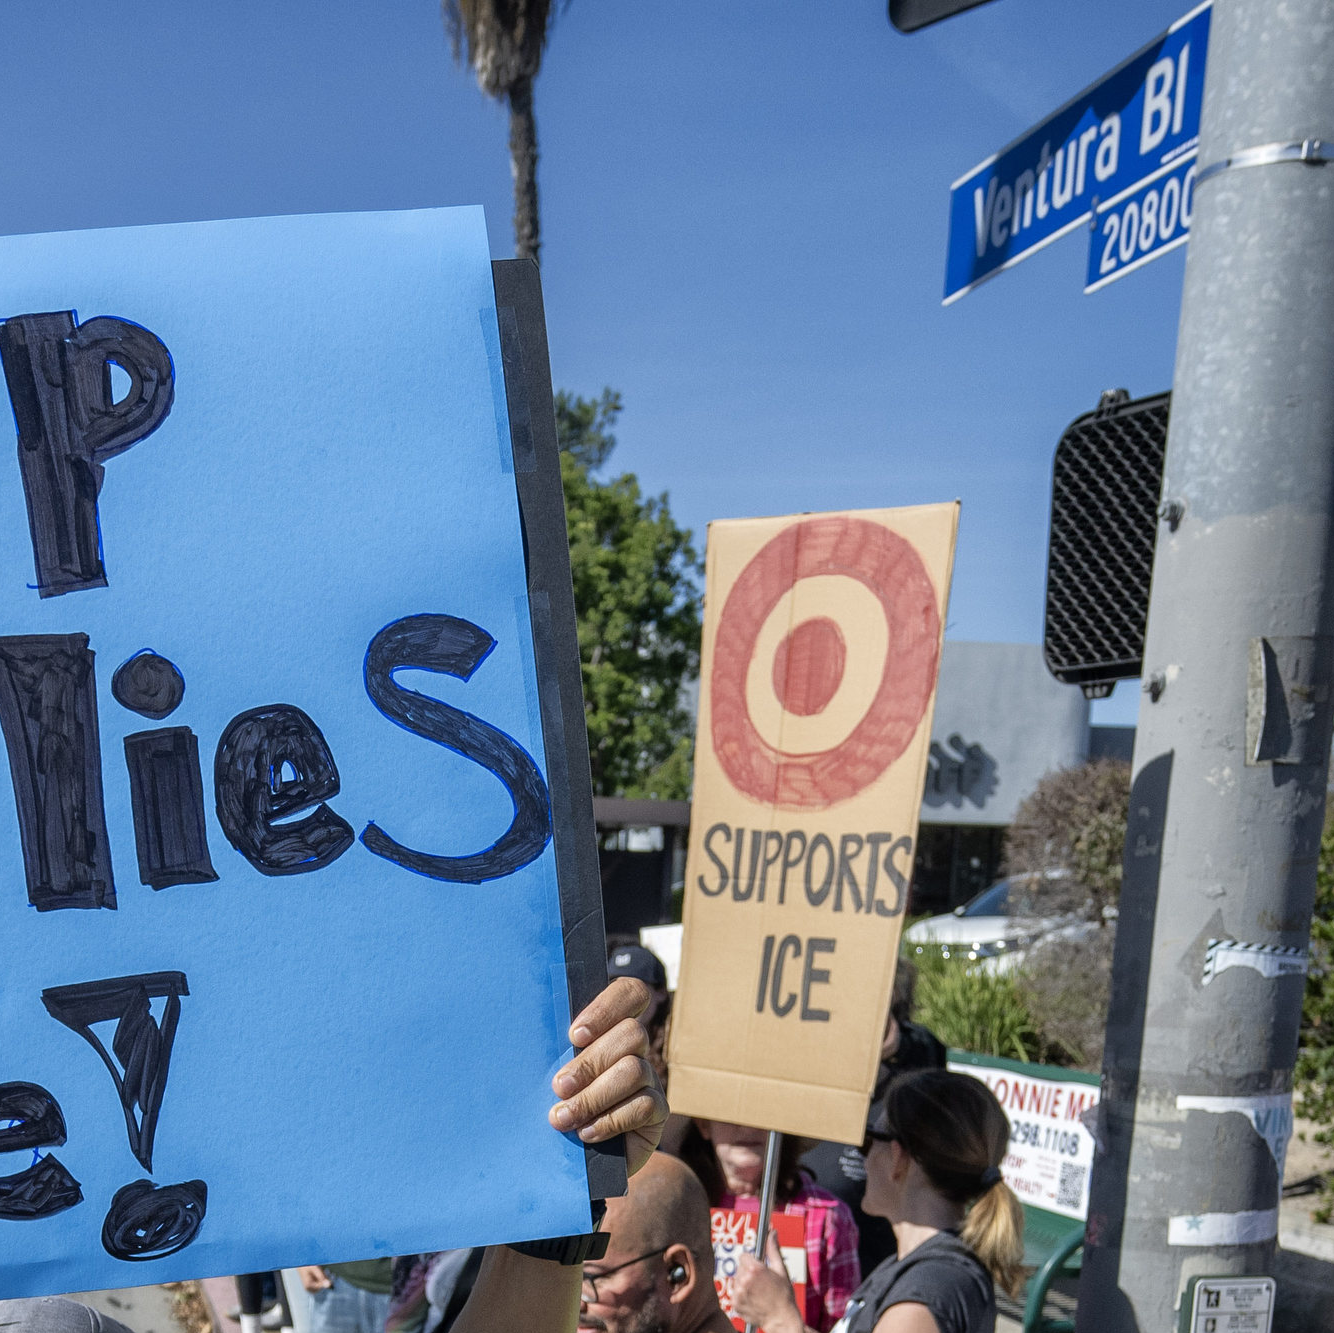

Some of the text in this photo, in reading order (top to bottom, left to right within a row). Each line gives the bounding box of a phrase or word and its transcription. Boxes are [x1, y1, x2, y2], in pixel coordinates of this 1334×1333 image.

[974, 41, 1191, 258] Ventura Bl
[698, 821, 913, 917] SUPPORTS
[755, 933, 837, 1022] ICE
[987, 1078, 1062, 1118] ONNIE
